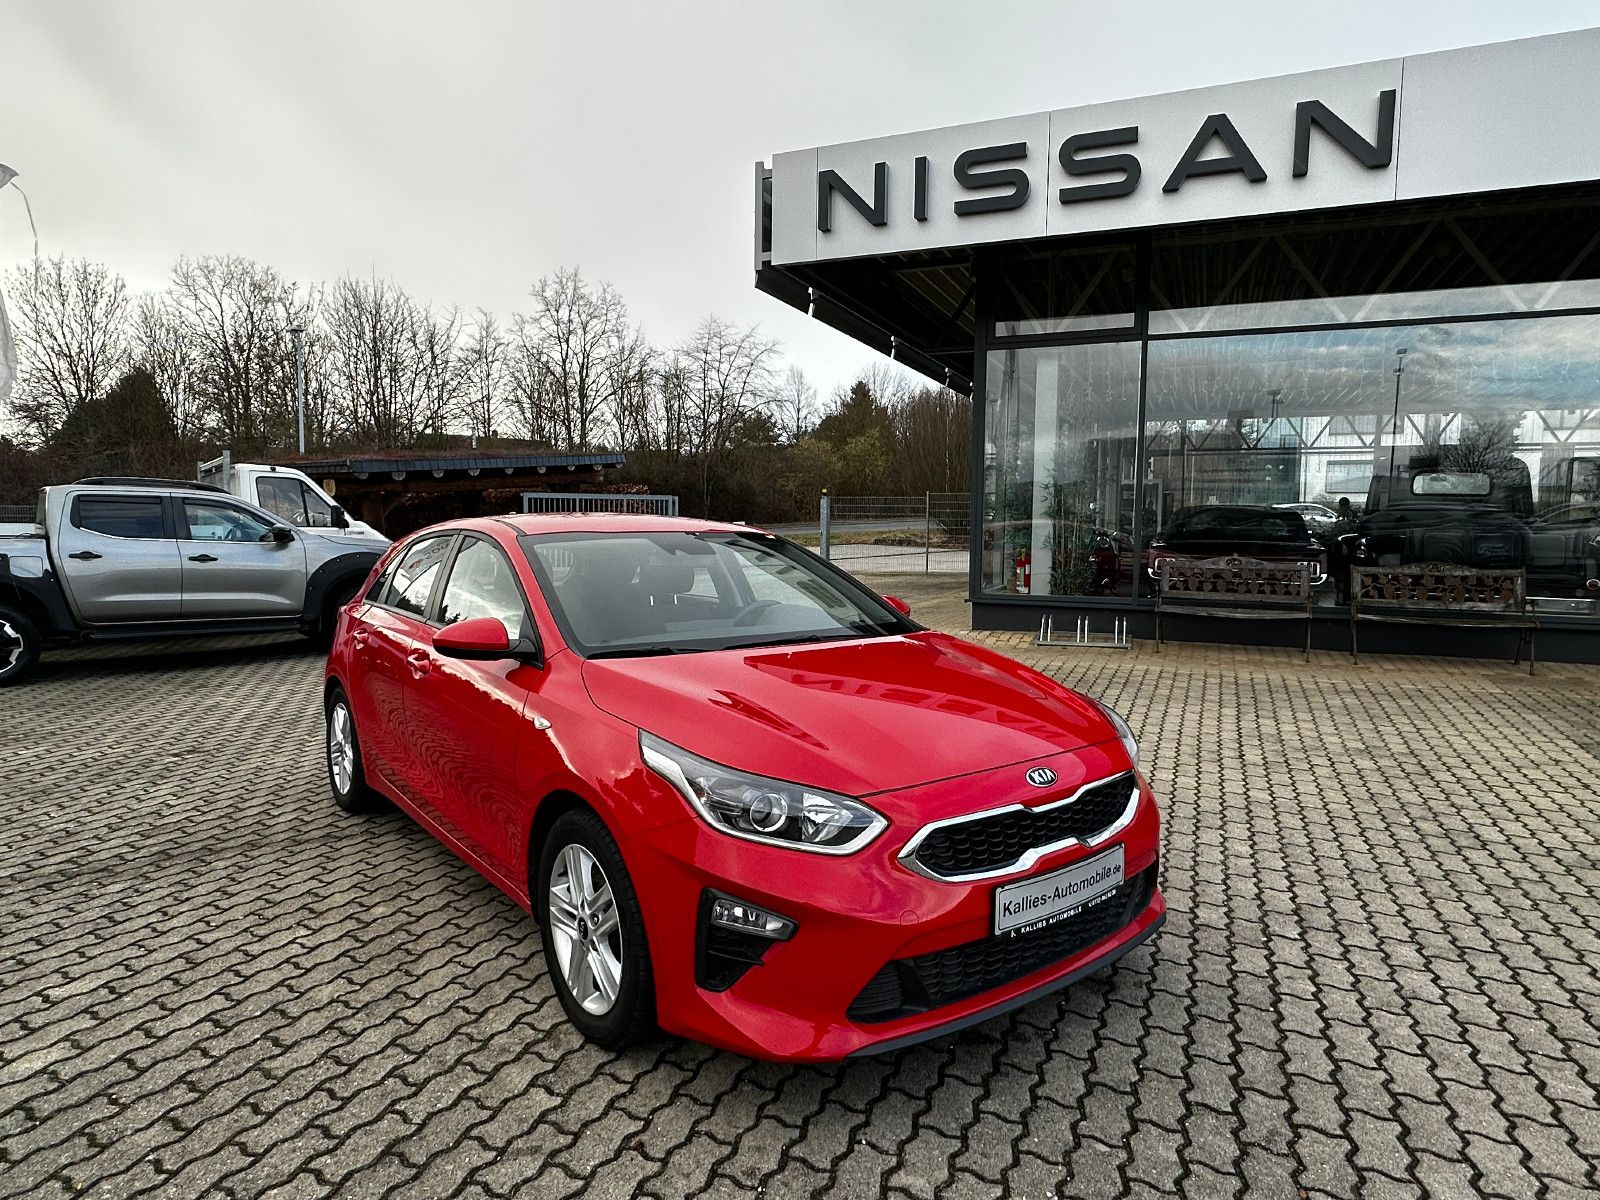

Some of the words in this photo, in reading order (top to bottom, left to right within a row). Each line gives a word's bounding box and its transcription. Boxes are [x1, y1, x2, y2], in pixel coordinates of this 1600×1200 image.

[818, 88, 1397, 232] NISSAN
[1029, 768, 1056, 784] KIA
[1002, 864, 1122, 918] Kallies-Automobile.de
[1021, 919, 1047, 934] KALLIES
